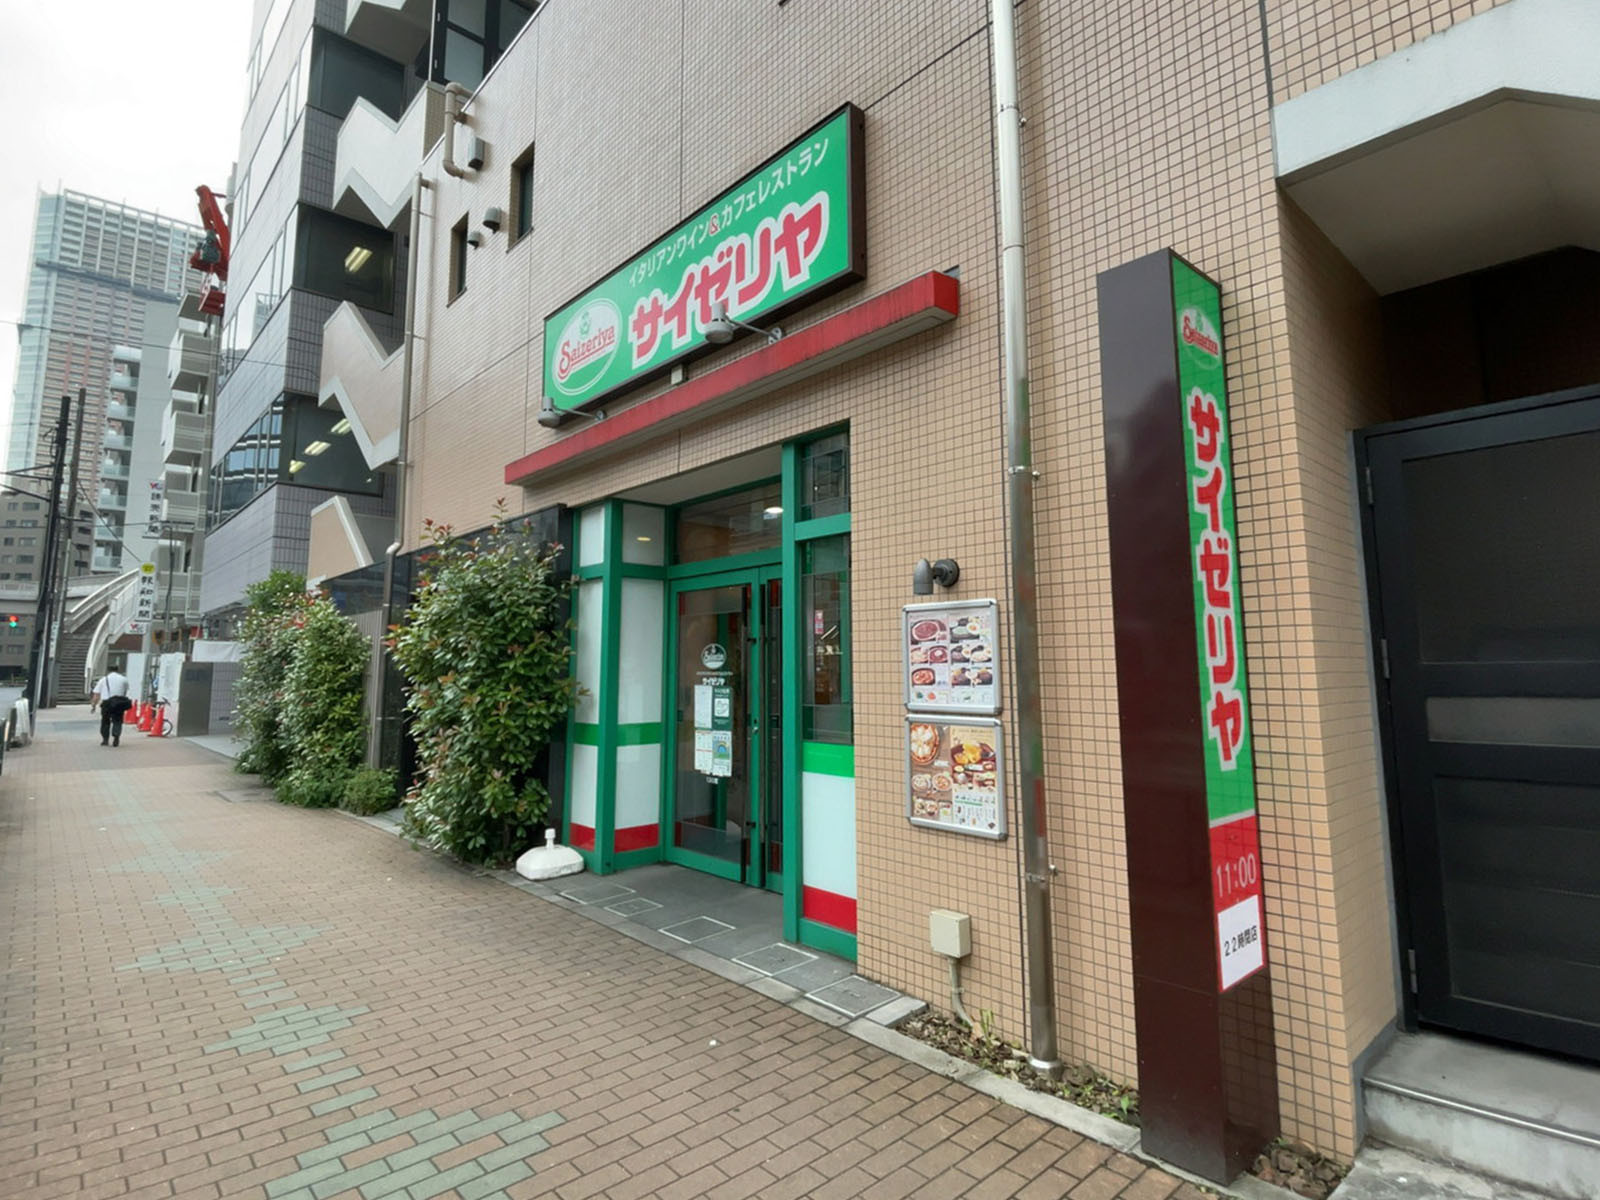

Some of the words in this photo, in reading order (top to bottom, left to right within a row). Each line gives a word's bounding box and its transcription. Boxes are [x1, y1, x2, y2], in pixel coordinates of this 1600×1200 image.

[629, 138, 829, 288] イタリアンワイン&カフェレストラン
[630, 197, 826, 364] サイゼリヤ
[557, 325, 616, 380] Saizeriya
[1188, 390, 1244, 766] サイゼリヤ
[1216, 853, 1257, 898] 11:00
